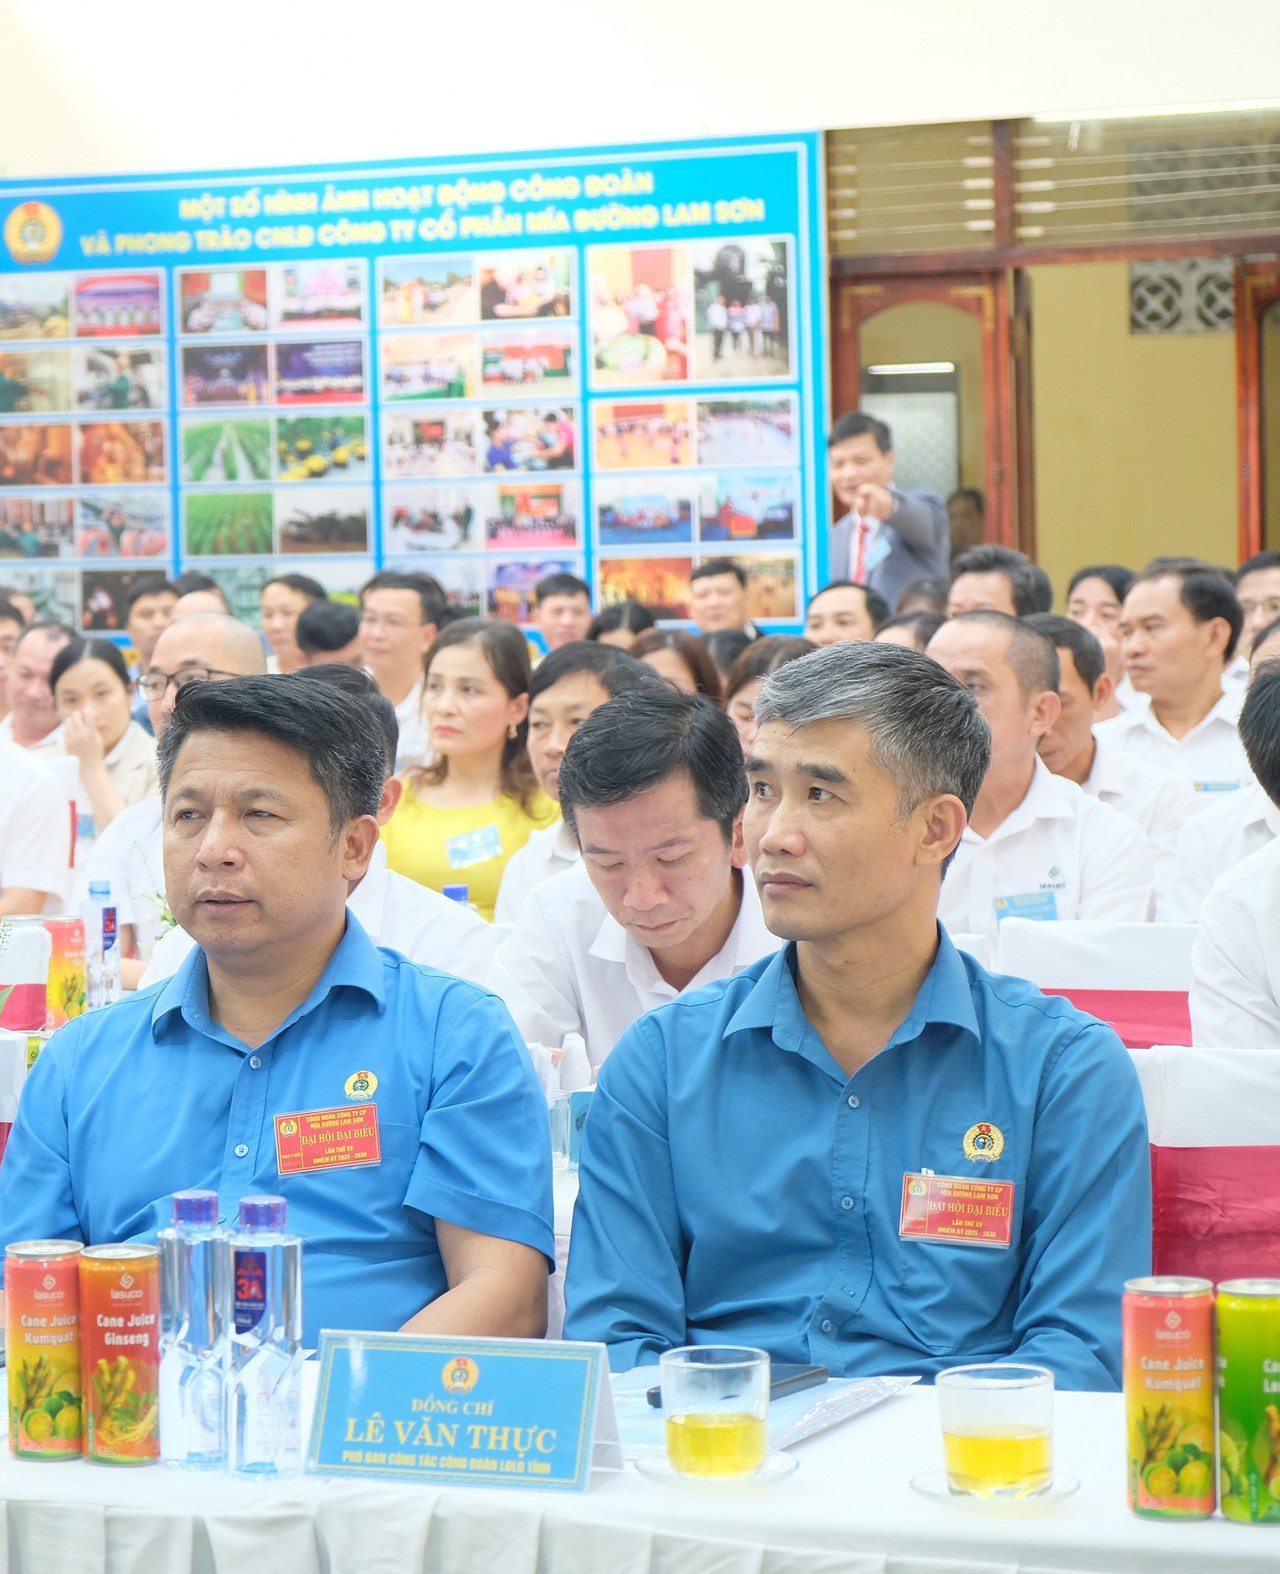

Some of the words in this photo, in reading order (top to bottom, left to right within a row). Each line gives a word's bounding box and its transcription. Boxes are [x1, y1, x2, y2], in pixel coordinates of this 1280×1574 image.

[179, 193, 225, 223] MỘT
[229, 186, 261, 217] SỐ
[373, 184, 434, 213] HOẠT
[437, 178, 505, 210] ĐỘNG
[509, 173, 581, 203] CÔNG
[584, 167, 654, 198] ĐOÀN
[80, 229, 111, 256] VÀ
[114, 231, 191, 255] PHONG
[194, 224, 252, 252] TRÀO
[317, 218, 387, 246] CÔNG
[389, 218, 416, 242] TY
[419, 206, 456, 241] CỔ
[525, 206, 570, 235] MÍA
[574, 203, 659, 233] ĐƯỜNG
[662, 201, 711, 228] LAM
[715, 197, 765, 224] SƠN
[301, 1134, 317, 1146] ĐẠI
[319, 1130, 335, 1144] HỘI
[336, 1130, 352, 1141] ĐẠI
[354, 1123, 375, 1138] BIỂU
[929, 1200, 946, 1213] ĐẠI
[948, 1200, 965, 1215] HỘI
[967, 1204, 983, 1216] ĐẠI
[986, 1202, 1008, 1217] BIỂU
[34, 1289, 64, 1300] lasuco
[110, 1289, 143, 1300] lasuco
[236, 1277, 263, 1299] 3A
[21, 1314, 47, 1327] Cane
[49, 1313, 77, 1327] Juice
[97, 1313, 125, 1327] Cane
[127, 1312, 156, 1328] Juice
[24, 1331, 74, 1347] Kumquat
[104, 1331, 150, 1347] Ginseng
[1140, 1356, 1171, 1371] Cane
[1173, 1356, 1205, 1371] Juice
[1144, 1376, 1202, 1392] Kumquat
[411, 1394, 459, 1415] ĐỒNG
[462, 1400, 494, 1417] CHÍ
[344, 1412, 386, 1445] LÊ
[394, 1416, 458, 1449] VĂN
[467, 1423, 557, 1459] THỰC
[342, 1450, 363, 1463] PHÓ
[365, 1452, 387, 1464] BAN
[388, 1451, 416, 1467] CÔNG
[418, 1453, 437, 1468] TÁC
[439, 1455, 467, 1470] CÔNG
[470, 1457, 497, 1471] ĐOÀN
